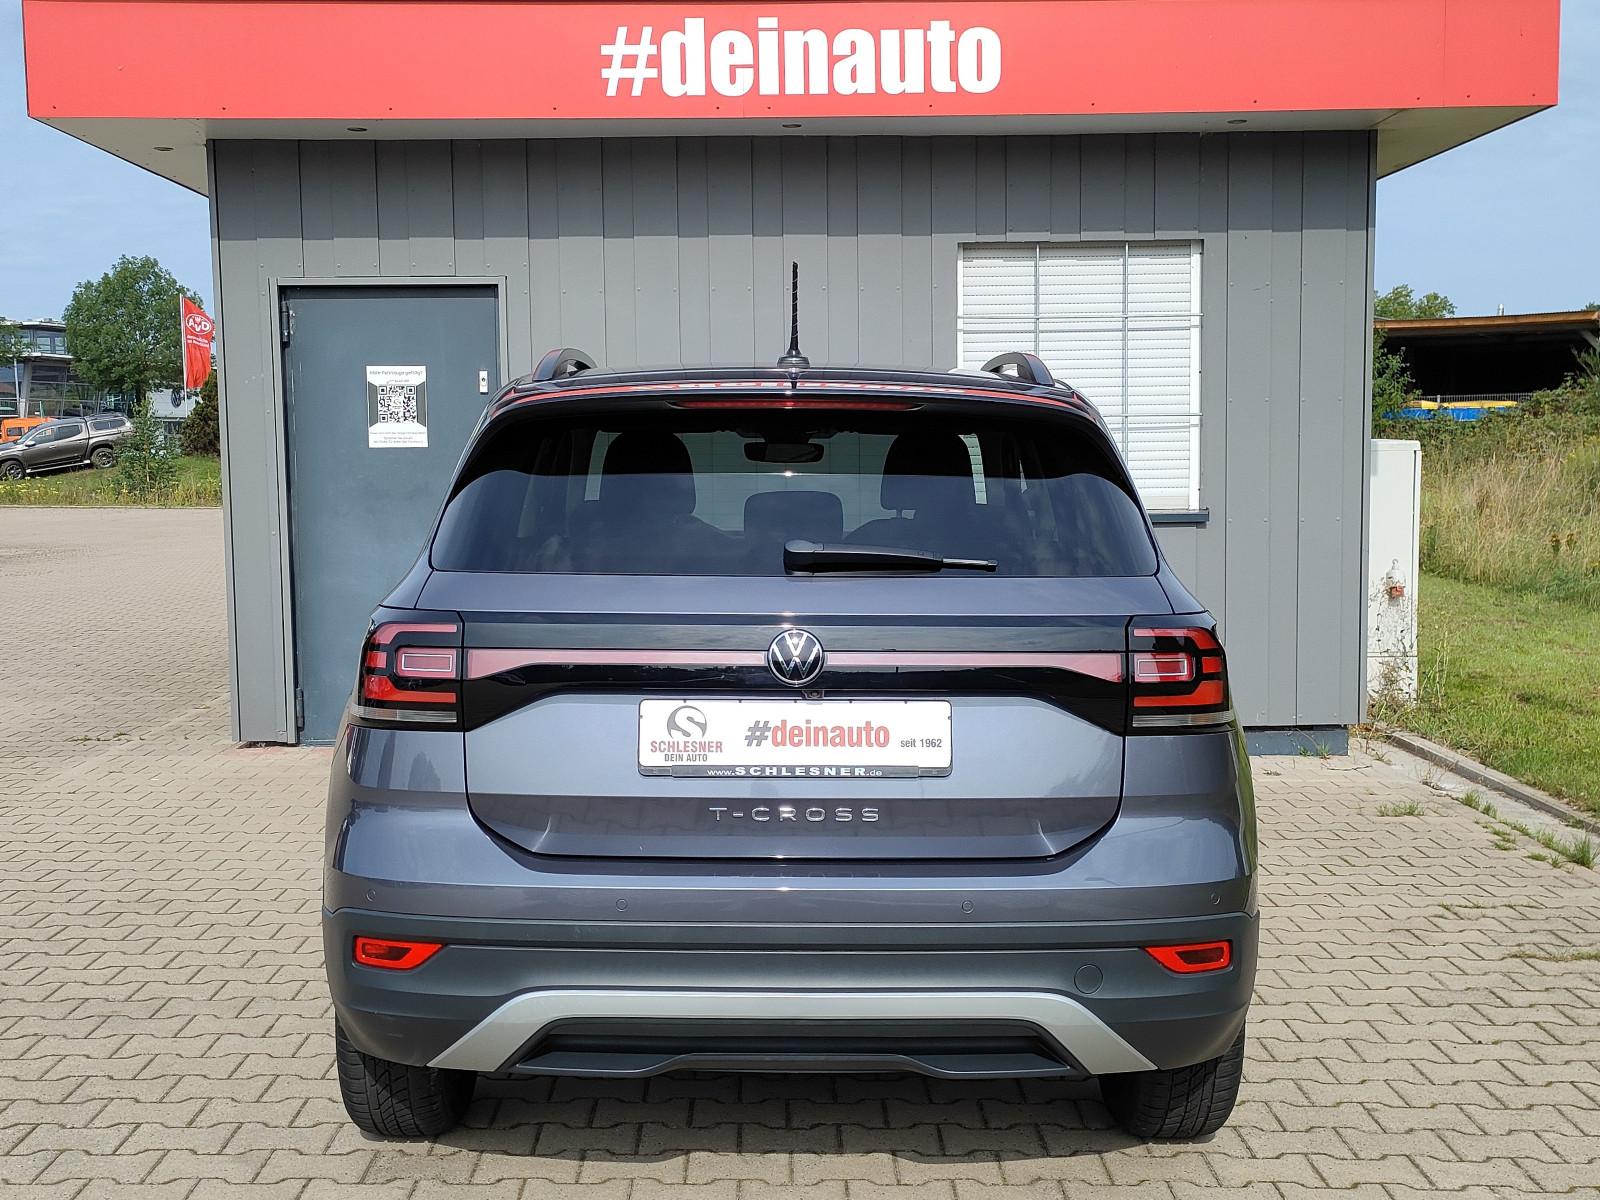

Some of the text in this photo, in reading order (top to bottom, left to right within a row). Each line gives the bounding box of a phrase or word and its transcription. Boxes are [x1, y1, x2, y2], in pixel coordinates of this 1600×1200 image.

[600, 16, 1002, 97] #deinauto
[744, 719, 890, 748] #deinauto
[650, 740, 723, 753] SCHLESNER
[900, 738, 943, 748] seit 1962
[664, 753, 708, 762] DEIN AUTO
[707, 766, 883, 777] www.SCHLESNER.de
[708, 806, 880, 822] T-CROSS
